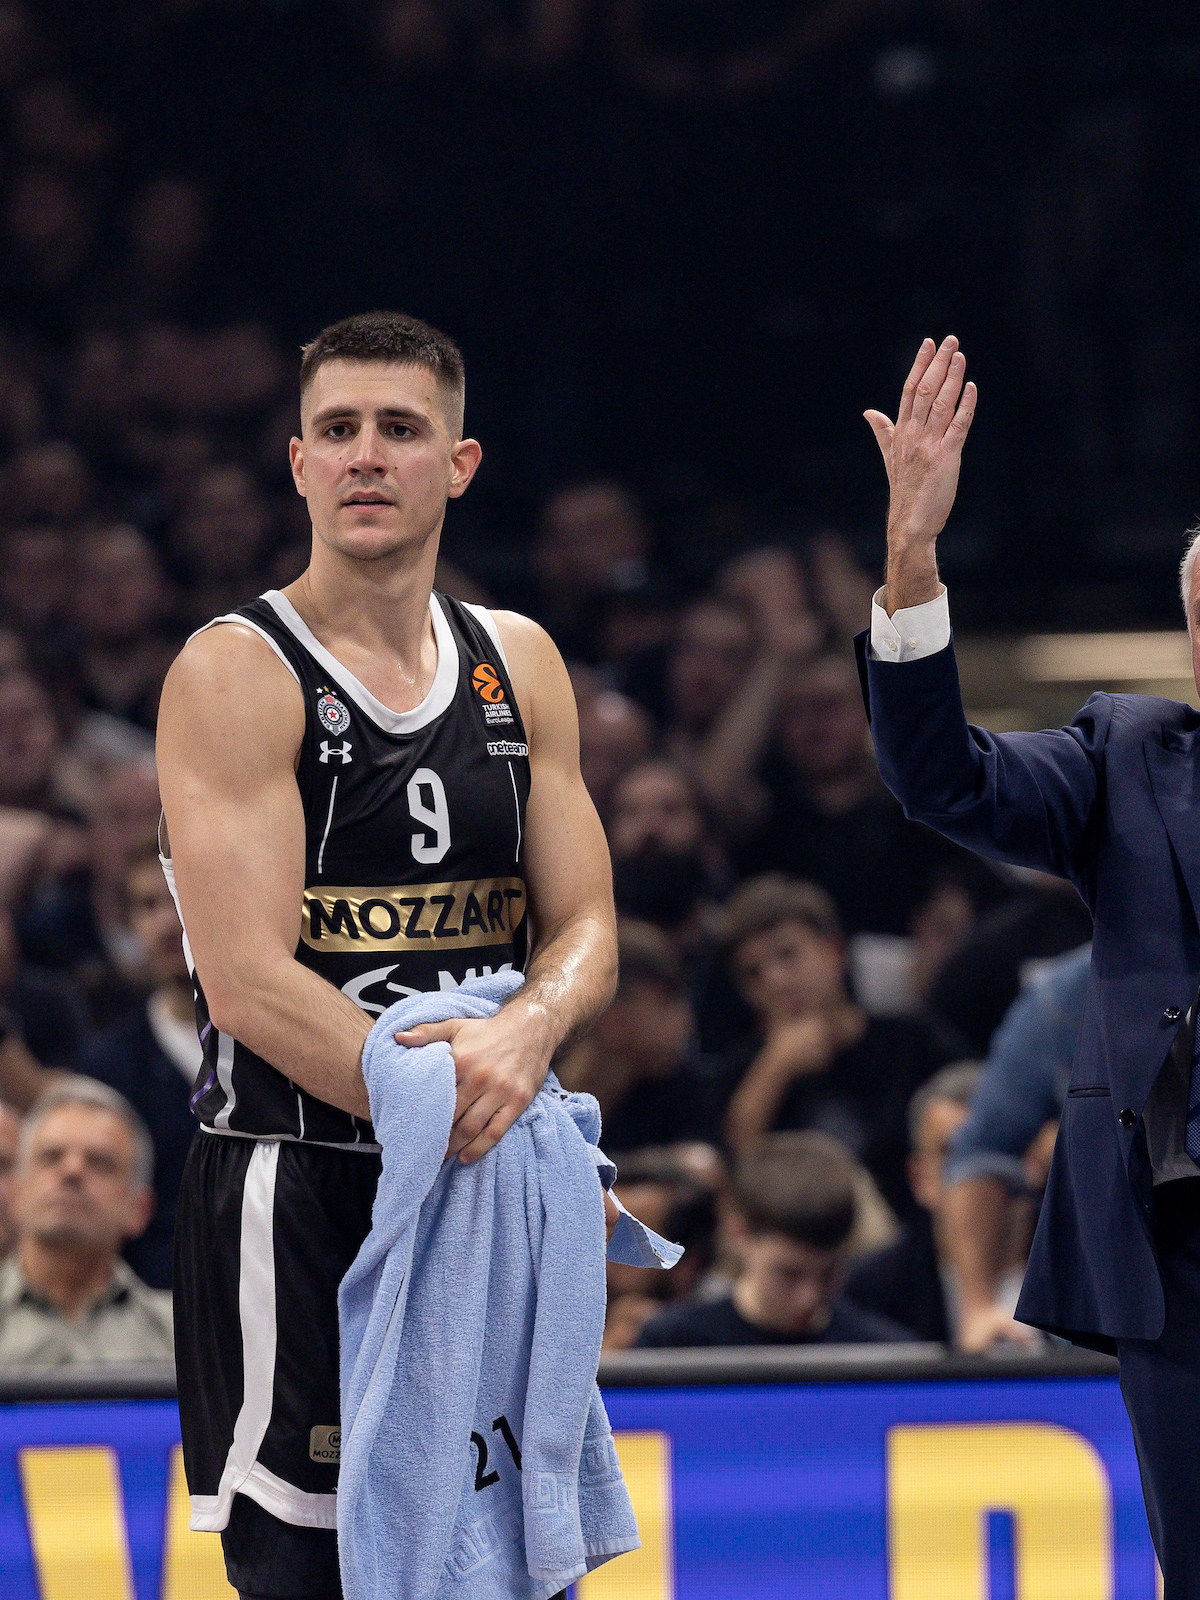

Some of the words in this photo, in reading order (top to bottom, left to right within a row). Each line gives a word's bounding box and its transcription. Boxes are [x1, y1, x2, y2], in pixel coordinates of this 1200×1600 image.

[408, 767, 451, 864] 9
[309, 888, 522, 940] MOZZART
[470, 1415, 522, 1492] 21
